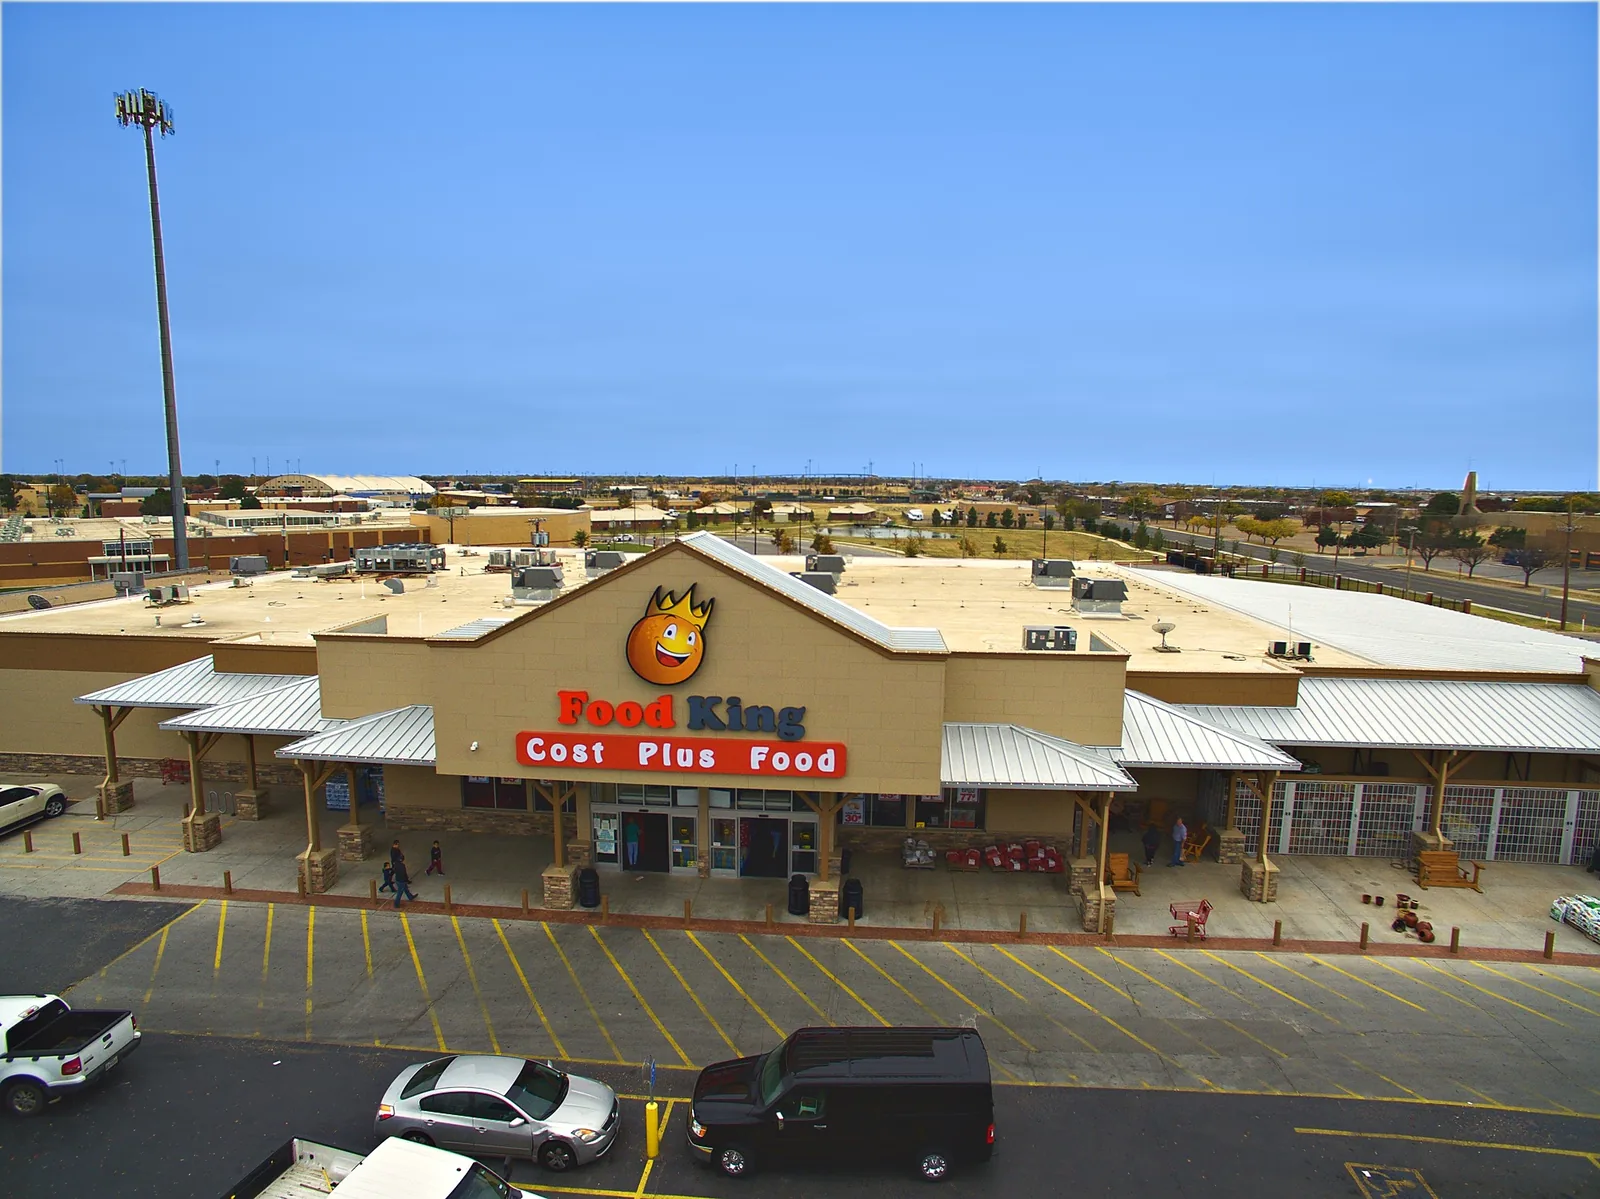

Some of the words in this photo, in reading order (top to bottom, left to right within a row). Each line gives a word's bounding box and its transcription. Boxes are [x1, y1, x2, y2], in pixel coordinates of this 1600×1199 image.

[557, 690, 676, 729] Food
[686, 695, 806, 741] King
[526, 737, 604, 764] Cost
[638, 742, 715, 768] Plus
[750, 746, 836, 773] Food
